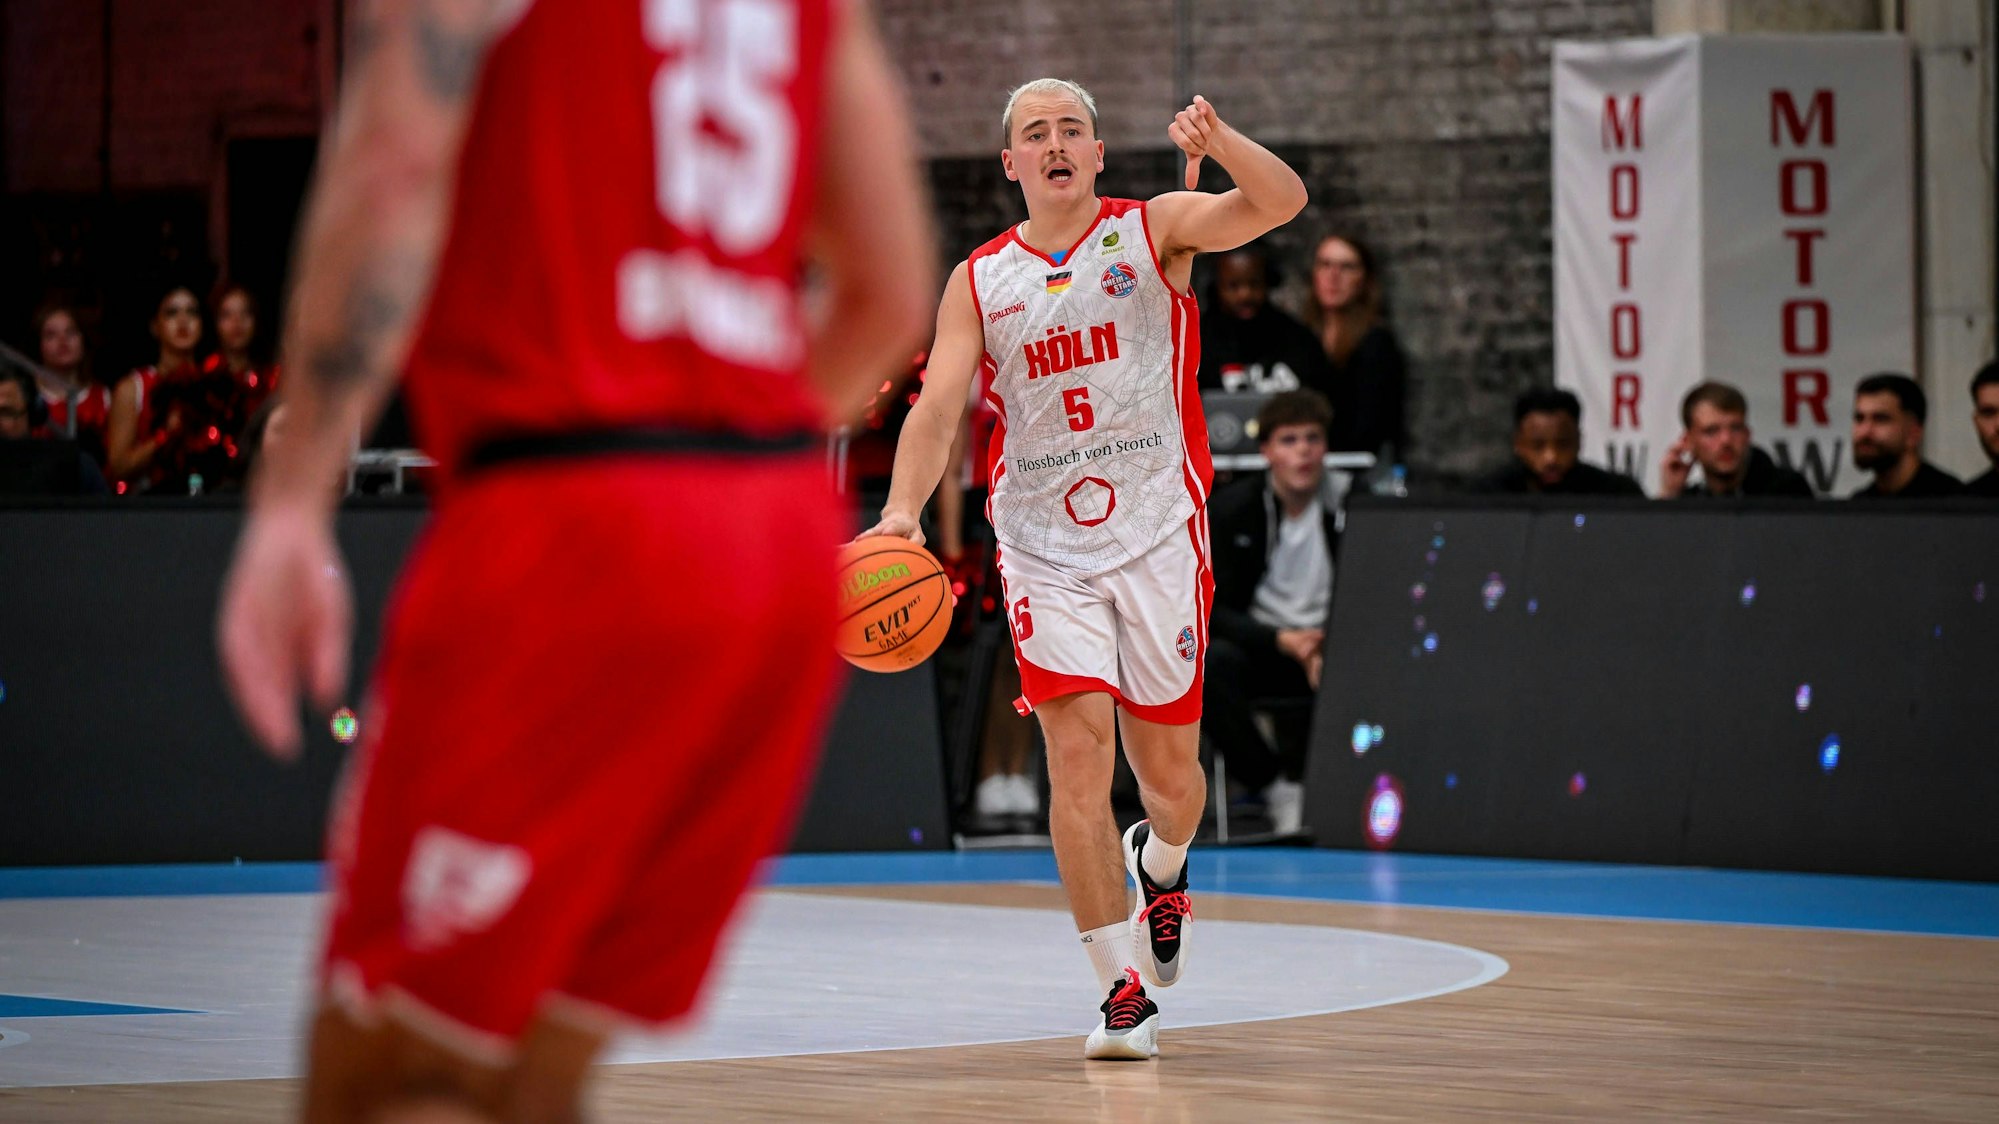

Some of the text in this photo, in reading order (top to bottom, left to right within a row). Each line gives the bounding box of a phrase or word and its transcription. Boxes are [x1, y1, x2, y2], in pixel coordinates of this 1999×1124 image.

[1102, 275, 1124, 288] RHEIN
[1113, 278, 1137, 292] STARS
[988, 300, 1026, 324] SPALDING
[1023, 321, 1119, 380] KÖLN
[1062, 386, 1095, 432] 5
[1016, 432, 1163, 473] Flossbach von Storch
[842, 562, 912, 606] ilson
[864, 605, 911, 643] EVO
[1013, 596, 1035, 643] 5
